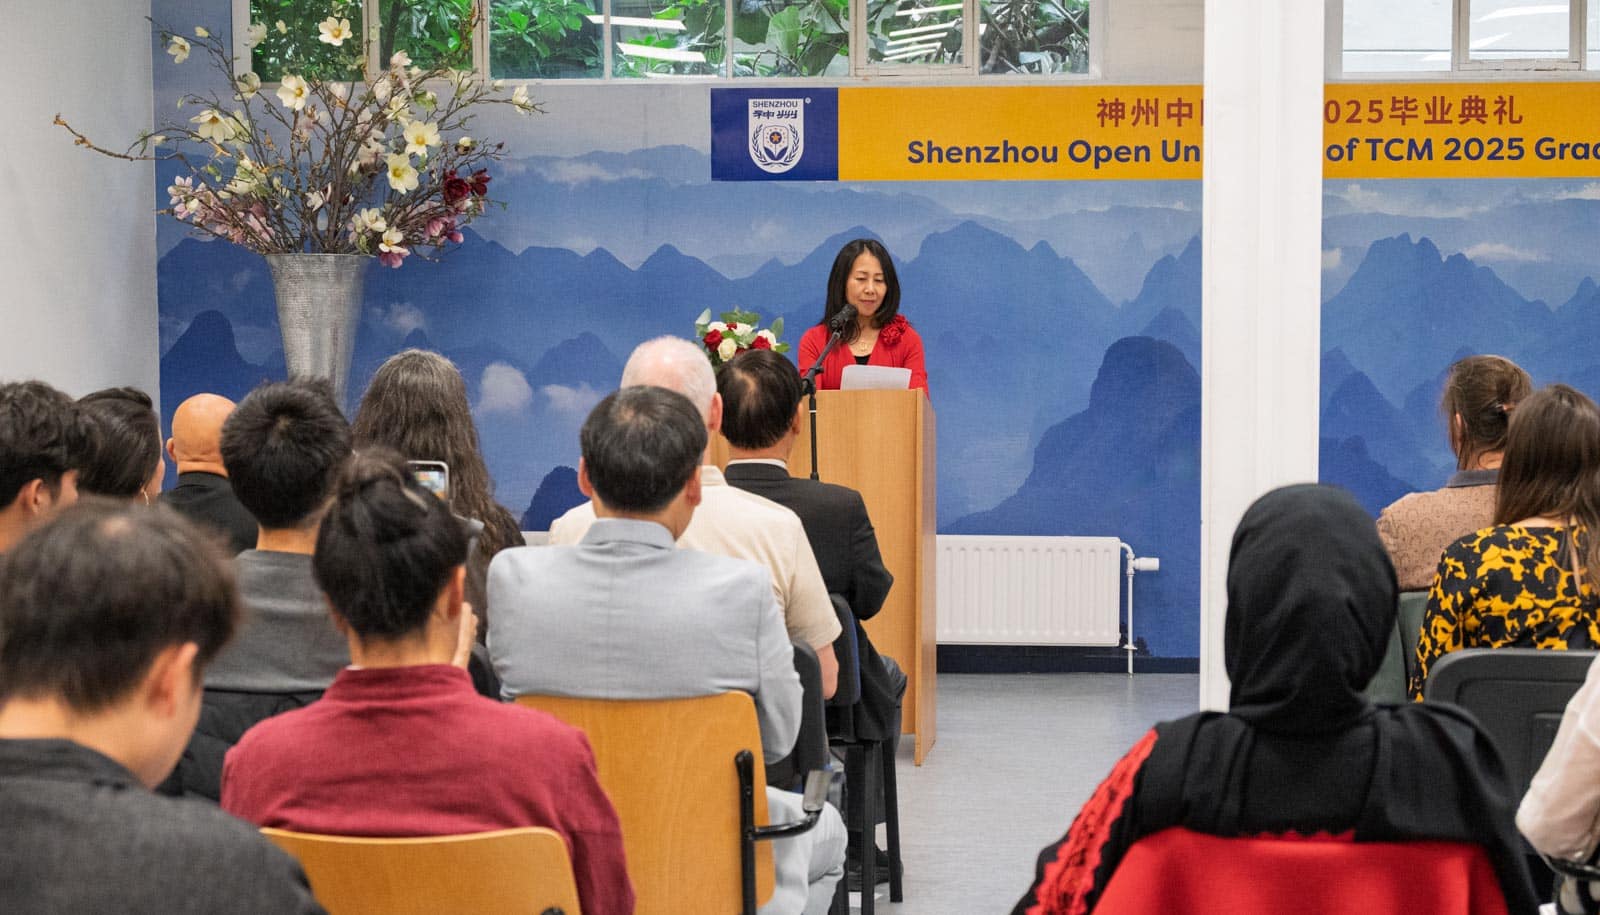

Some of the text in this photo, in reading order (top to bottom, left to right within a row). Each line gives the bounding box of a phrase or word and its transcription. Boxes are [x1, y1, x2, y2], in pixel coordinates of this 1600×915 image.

[752, 100, 798, 108] SHENZHOU
[1096, 95, 1523, 128] 神州中 025毕业典礼
[907, 139, 1058, 164] Shenzhou
[1068, 139, 1151, 170] Open
[1161, 139, 1201, 163] Un
[1325, 137, 1361, 162] of
[1364, 137, 1434, 162] TCM
[1443, 137, 1525, 161] 2025
